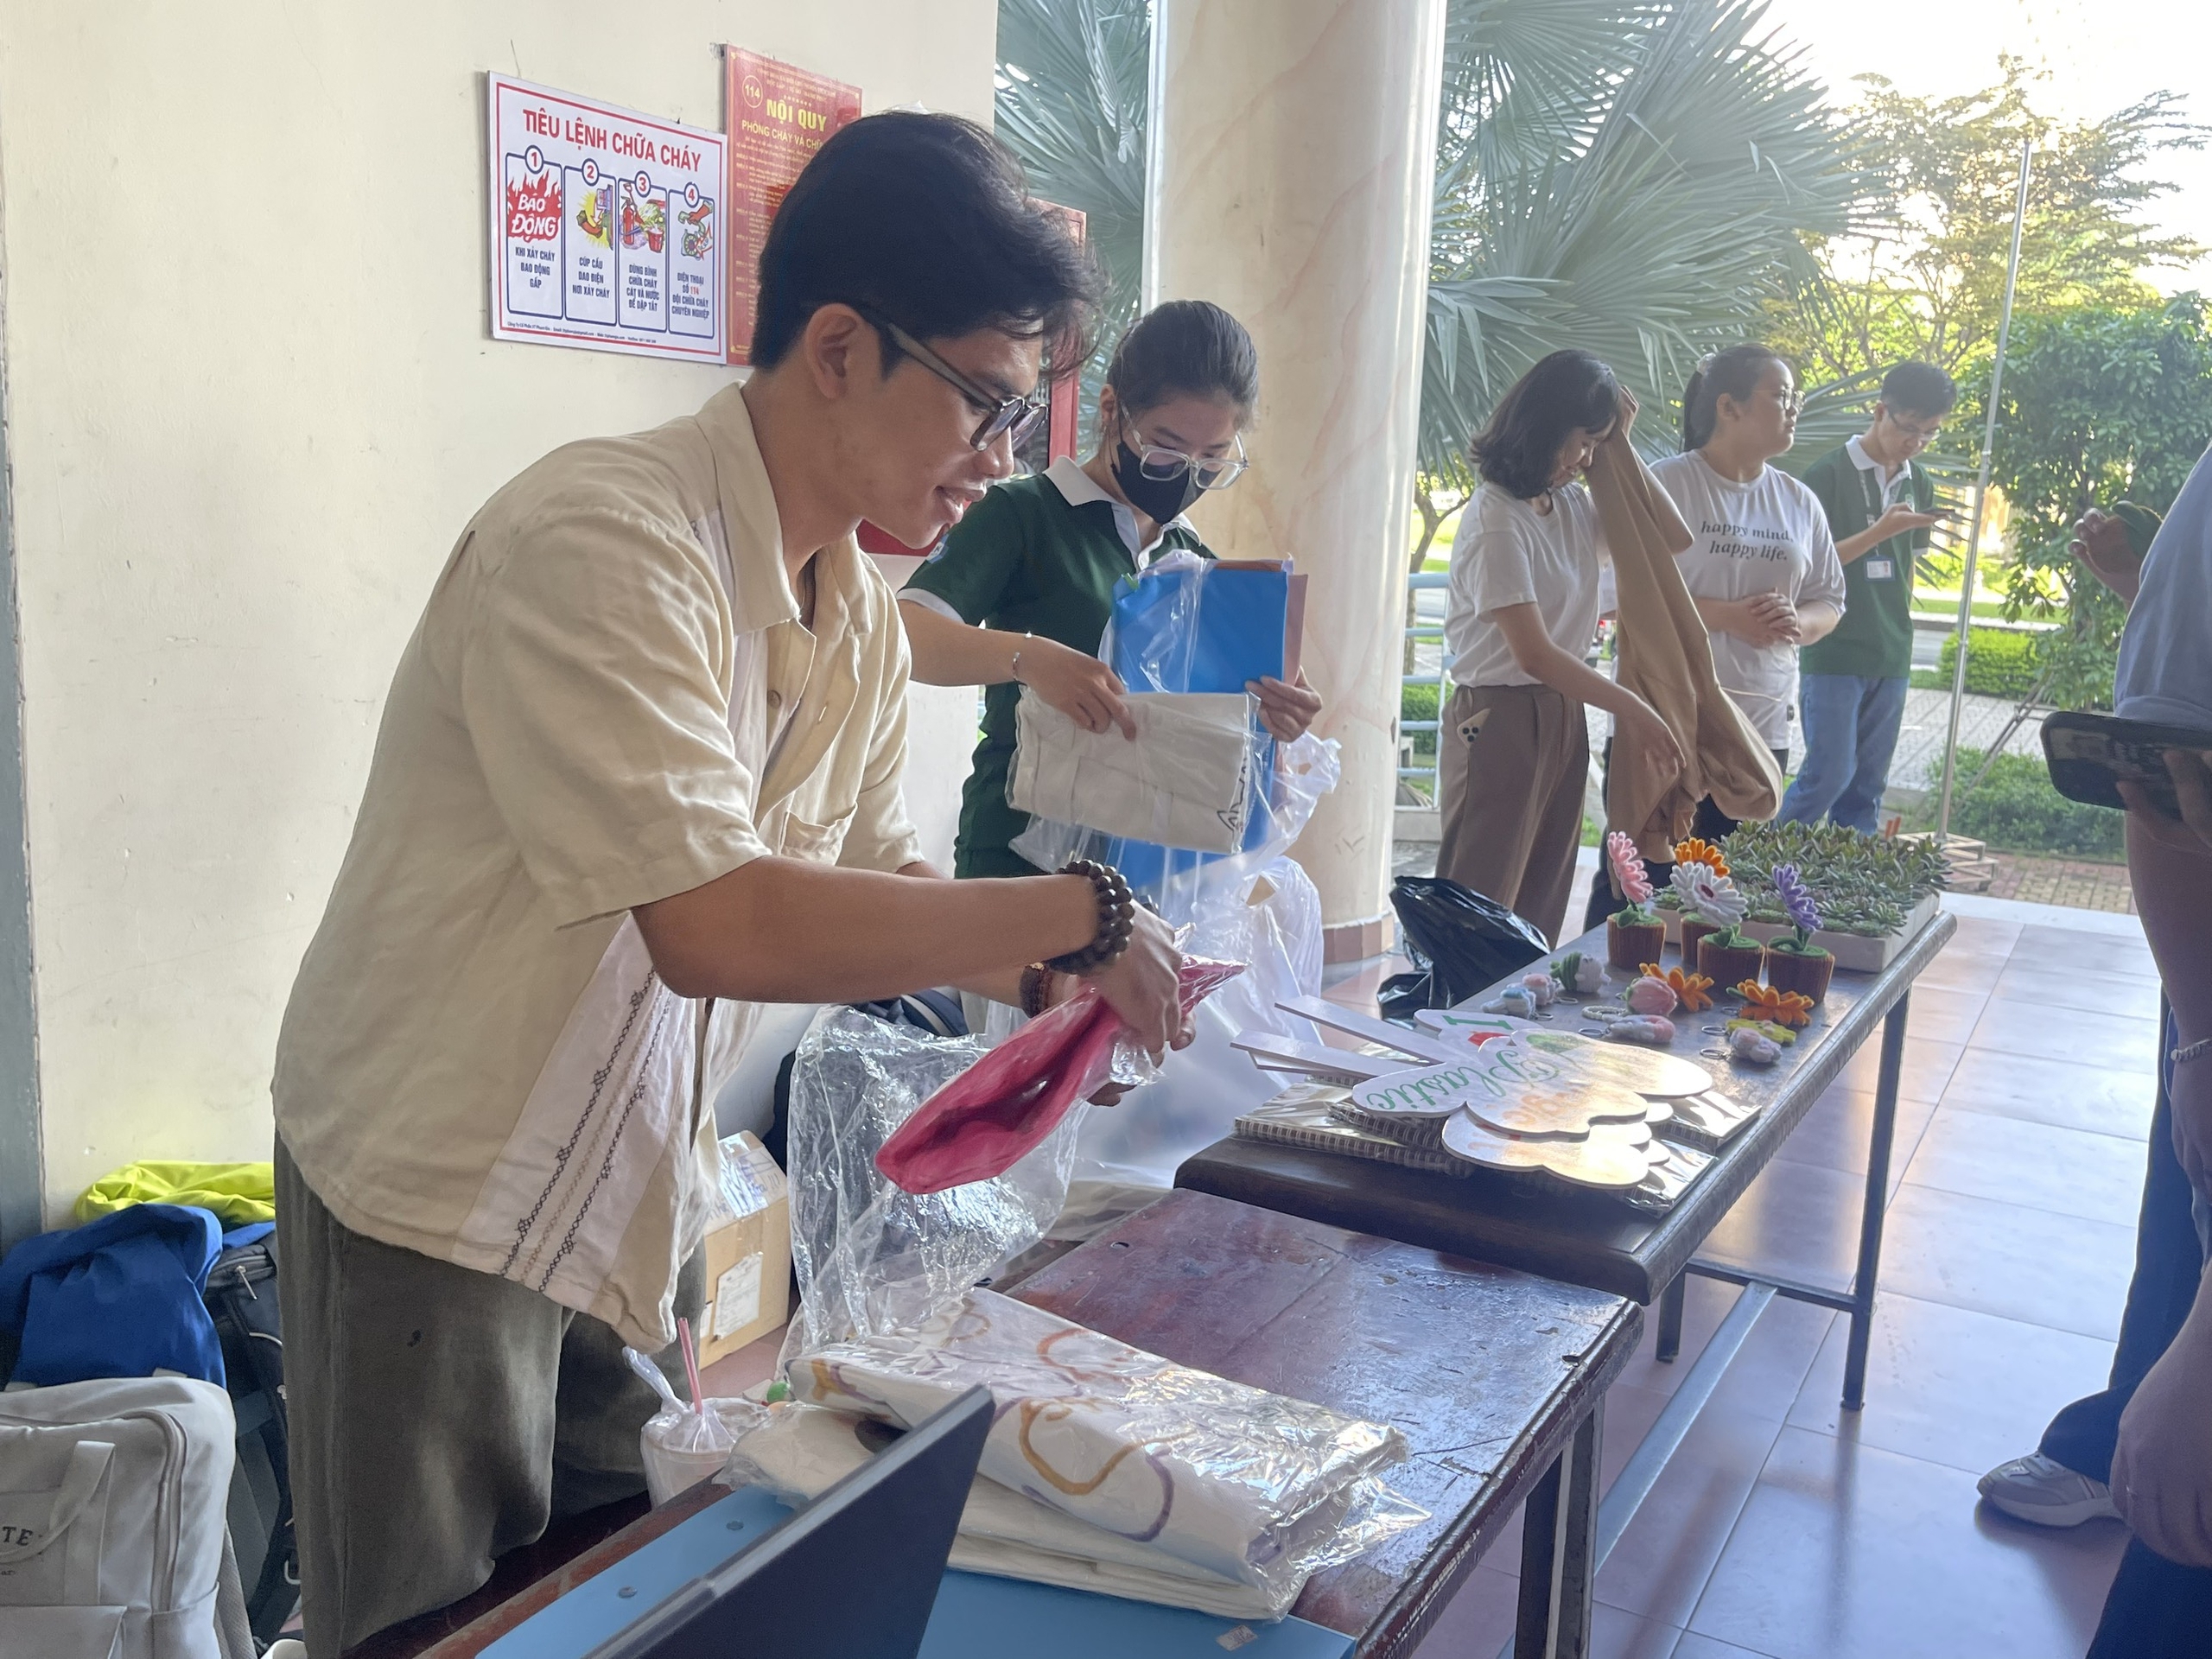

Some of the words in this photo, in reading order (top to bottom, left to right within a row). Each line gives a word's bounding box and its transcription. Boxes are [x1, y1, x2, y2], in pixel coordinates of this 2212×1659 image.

[745, 85, 760, 99] 114
[767, 99, 792, 124] NỘI
[798, 109, 827, 132] QUY
[523, 108, 560, 138] TIÊU
[566, 118, 607, 150] LỆNH
[613, 131, 656, 162] CHỮA
[661, 145, 701, 172] CHÁY
[742, 120, 770, 137] PHÒNG
[772, 129, 792, 143] CHÁY
[795, 134, 804, 147] VÀ
[531, 152, 537, 167] 1
[588, 165, 594, 180] 2
[639, 177, 647, 191] 3
[688, 188, 696, 201] 4
[518, 193, 546, 213] BÁO
[512, 213, 556, 241] ĐỘNG
[516, 247, 525, 257] KHI
[540, 250, 556, 262] CHÁY
[580, 256, 591, 267] CÚP
[530, 276, 542, 289] GẤP
[579, 271, 590, 282] DAO
[596, 288, 610, 299] CHÁY
[1701, 521, 1749, 537] happy
[1752, 528, 1794, 543] mind,
[1710, 541, 1758, 559] happy
[1761, 544, 1788, 562] life.
[1366, 1049, 1560, 1110] Plastic
